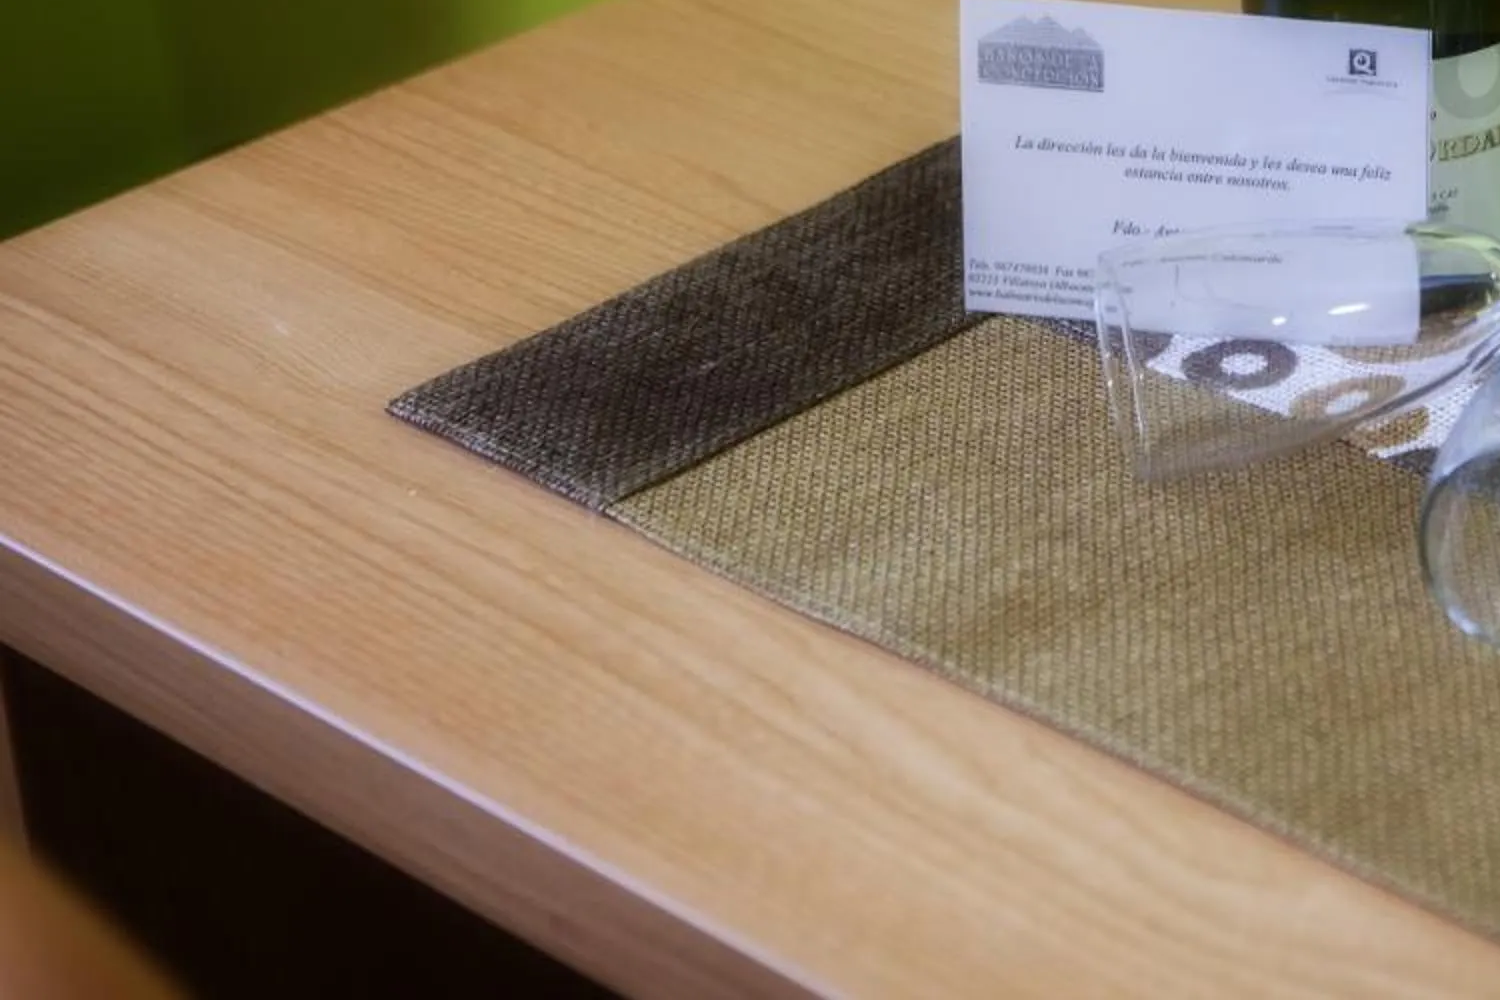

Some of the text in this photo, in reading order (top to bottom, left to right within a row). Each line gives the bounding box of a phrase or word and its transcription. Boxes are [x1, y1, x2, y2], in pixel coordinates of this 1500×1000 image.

[1015, 135, 1392, 183] La dirección les da la bienvenida y les desea una feliz
[1124, 167, 1183, 182] estancia
[1187, 172, 1223, 185] entre
